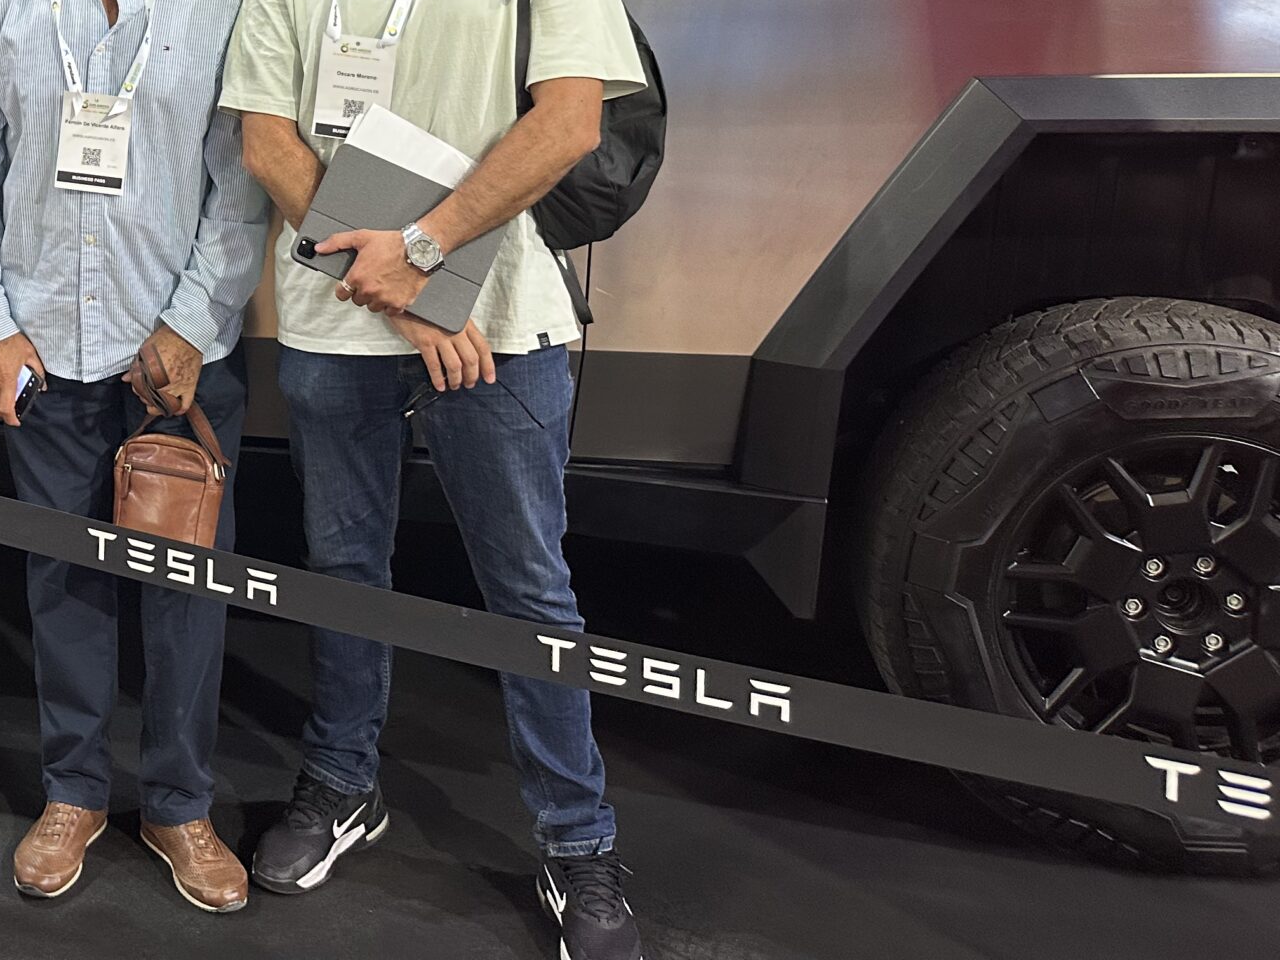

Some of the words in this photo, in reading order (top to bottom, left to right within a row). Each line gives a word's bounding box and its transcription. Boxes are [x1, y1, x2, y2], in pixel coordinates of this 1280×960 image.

[87, 527, 278, 606] TESLA
[536, 634, 791, 723] TESLA
[1144, 755, 1272, 820] TE
